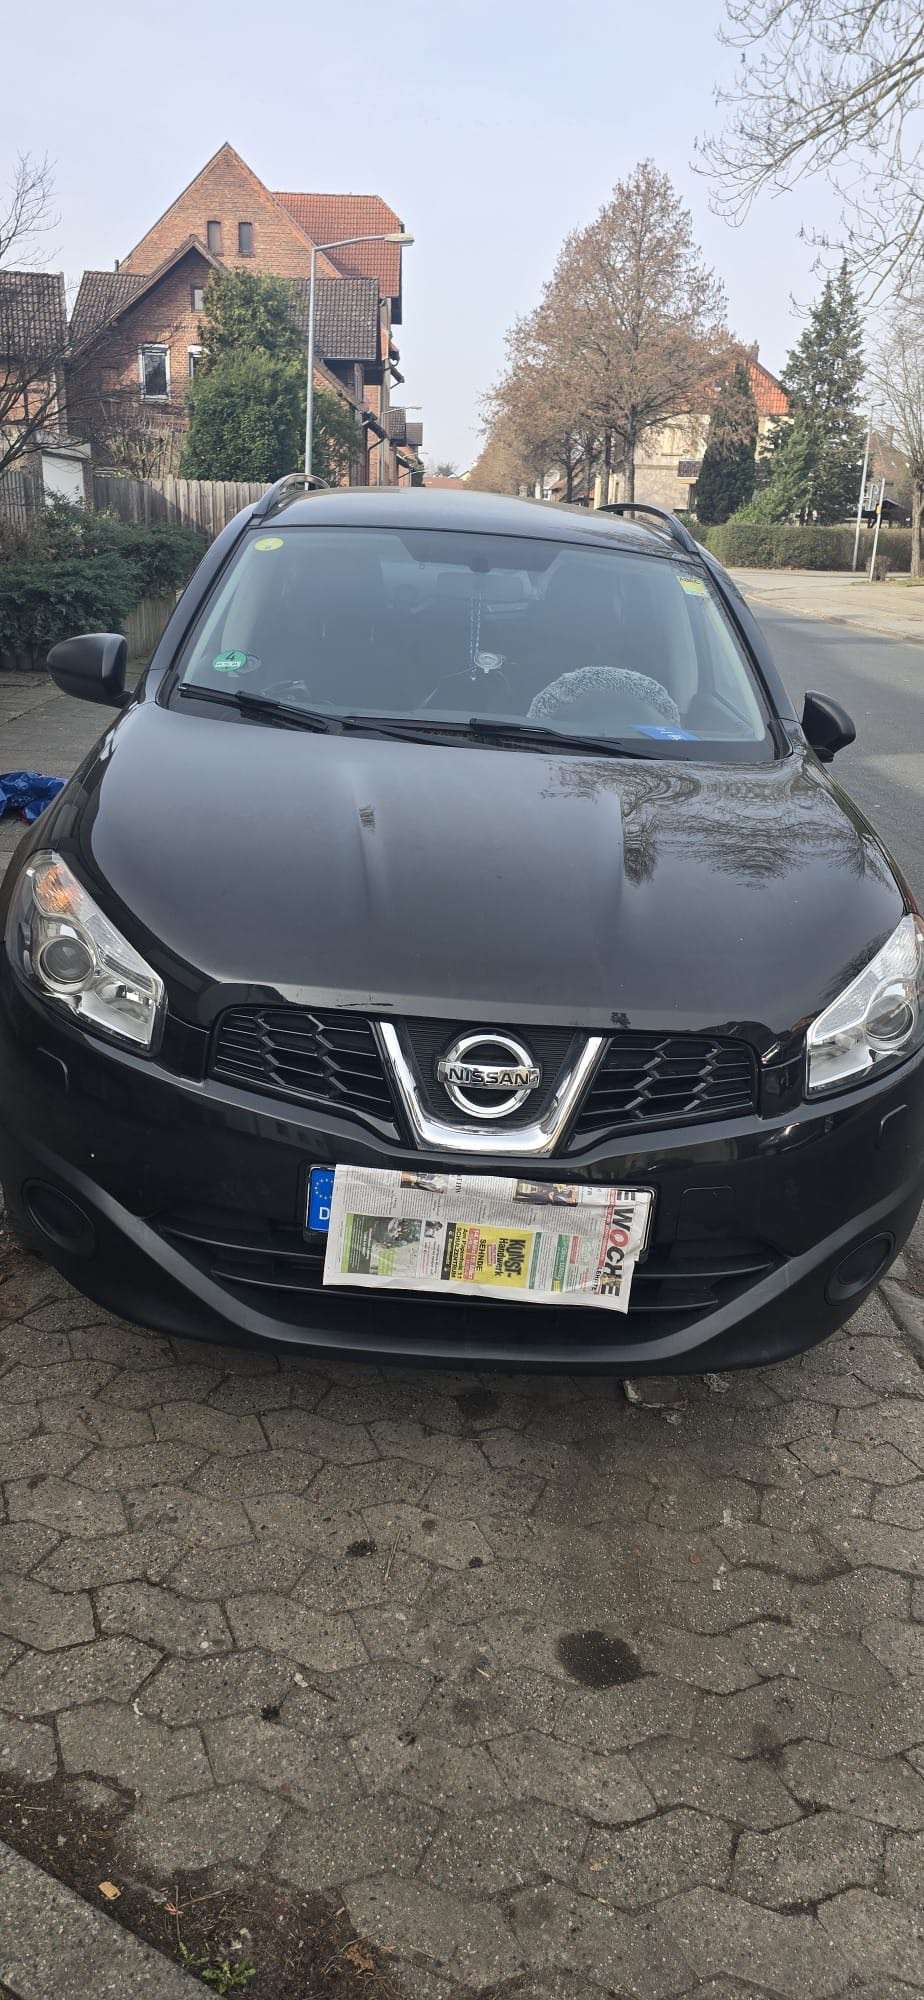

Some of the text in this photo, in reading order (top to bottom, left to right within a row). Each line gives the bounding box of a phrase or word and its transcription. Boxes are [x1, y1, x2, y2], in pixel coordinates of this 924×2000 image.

[225, 651, 236, 662] 4
[449, 1068, 529, 1086] NISSAN
[319, 1206, 330, 1220] D
[475, 1238, 487, 1272] SEHNDE
[494, 1237, 508, 1277] Handwerk
[503, 1239, 527, 1278] KUNST-
